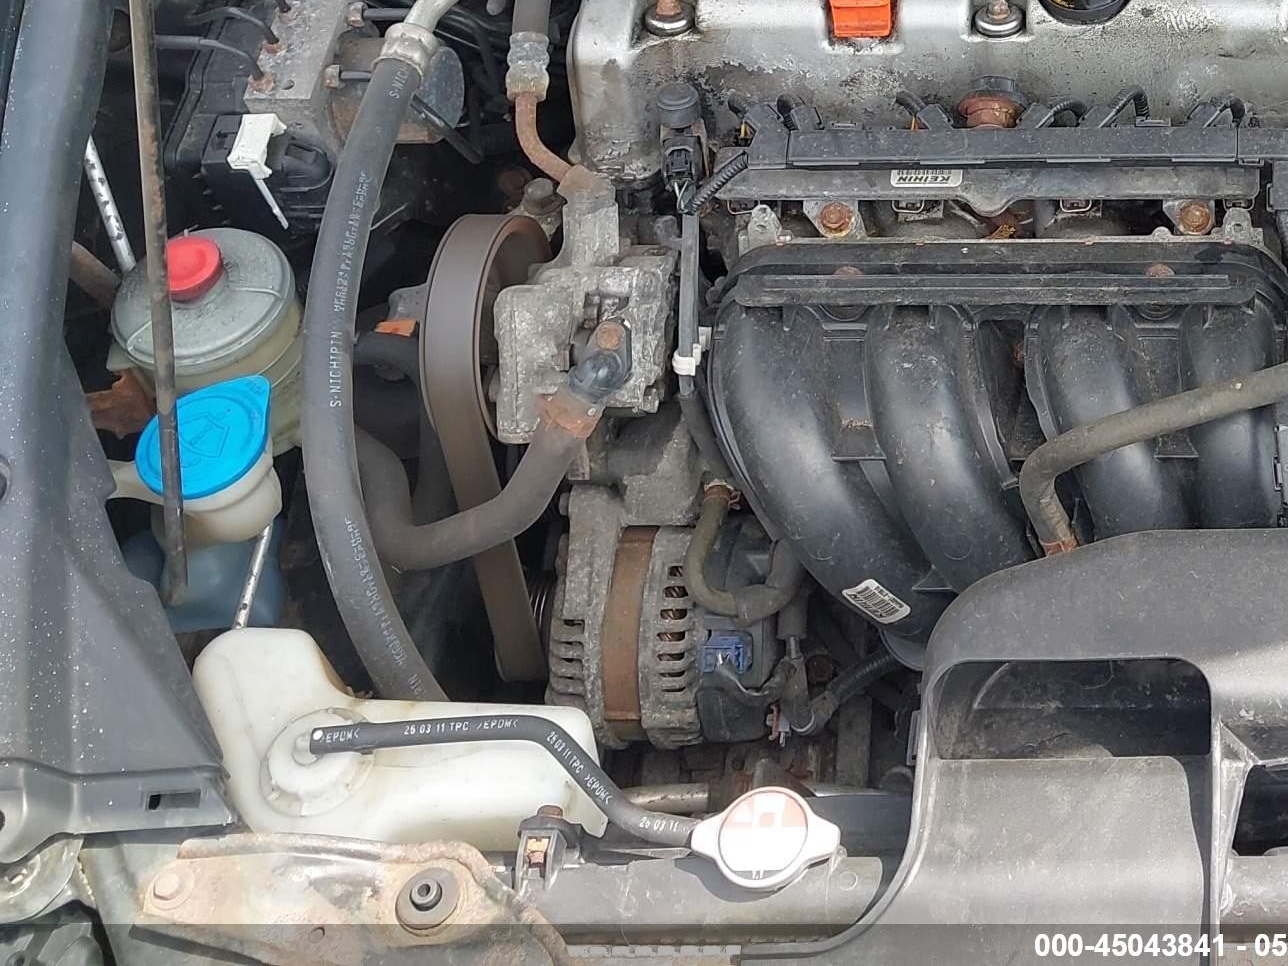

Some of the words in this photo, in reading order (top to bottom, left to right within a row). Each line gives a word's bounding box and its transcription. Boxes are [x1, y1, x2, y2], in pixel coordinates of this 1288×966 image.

[419, 724, 431, 734] 03
[450, 721, 469, 732] TPC
[554, 739, 566, 752] 03
[569, 756, 584, 774] TPC
[654, 819, 666, 831] 03
